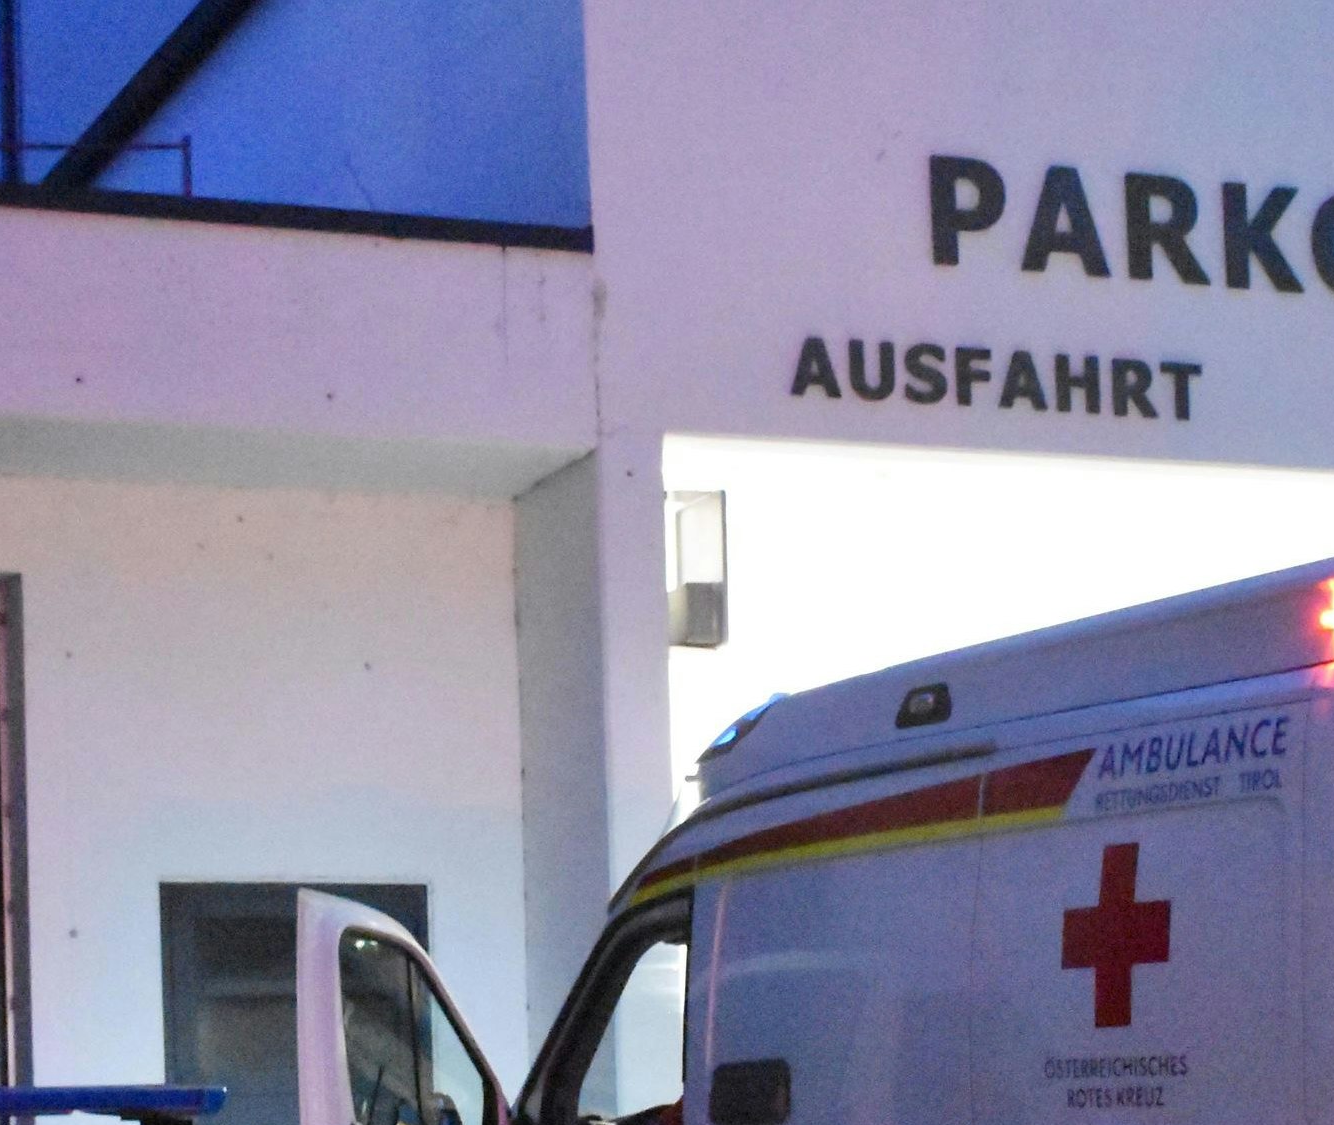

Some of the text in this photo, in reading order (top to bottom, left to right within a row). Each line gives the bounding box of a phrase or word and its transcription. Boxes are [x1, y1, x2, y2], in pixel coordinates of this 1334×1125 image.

[790, 336, 1202, 424] AUSFAHRT
[1097, 716, 1290, 779] AMBULANCE
[1239, 768, 1282, 792] TIROL
[1044, 1054, 1188, 1079] ÖSTERREICHISCHES
[1067, 1085, 1164, 1108] ROTES KREUZ
